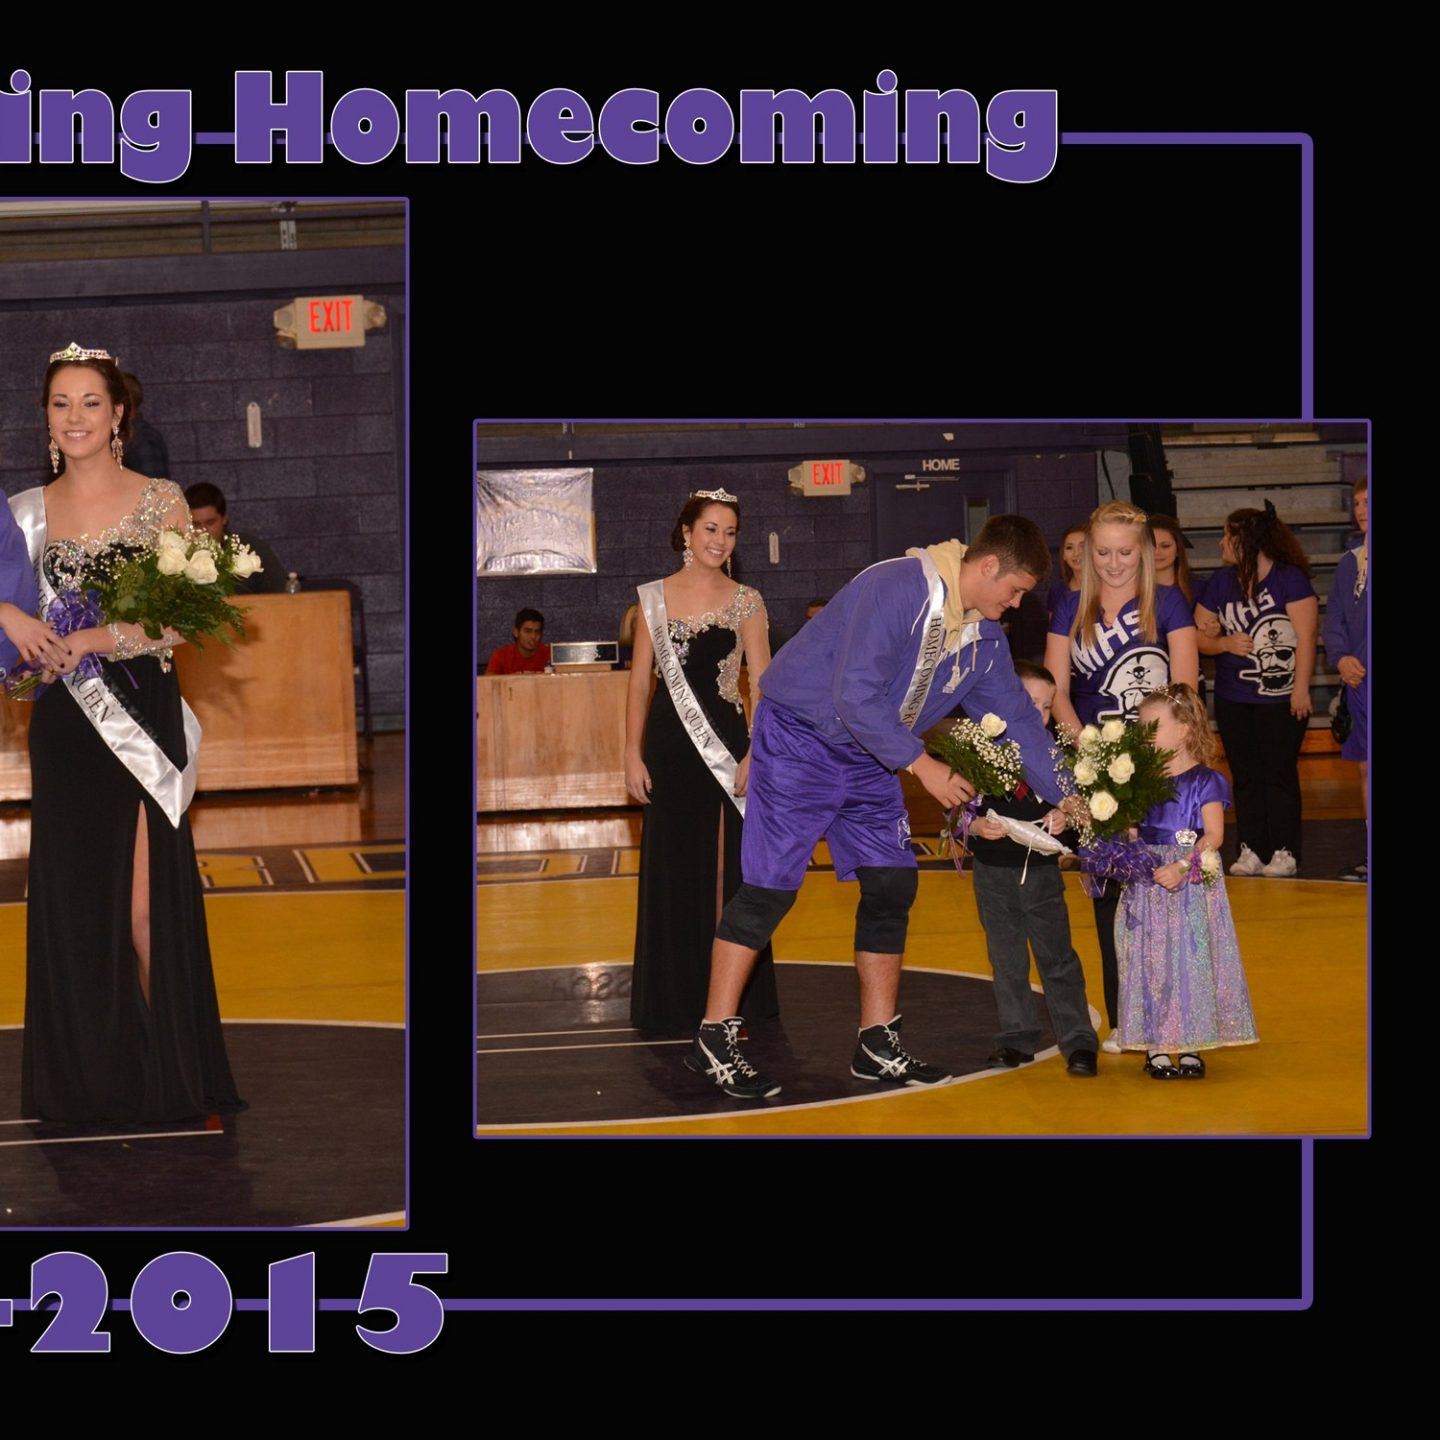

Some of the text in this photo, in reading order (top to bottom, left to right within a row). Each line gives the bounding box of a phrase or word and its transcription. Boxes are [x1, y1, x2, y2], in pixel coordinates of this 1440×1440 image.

[308, 299, 354, 334] EXIT
[812, 462, 844, 485] EXIT
[922, 458, 960, 472] HOME
[1217, 587, 1276, 636] MHS
[908, 617, 942, 711] HOMECOMING
[1071, 609, 1142, 680] MHS
[654, 625, 714, 749] HOMECOMING QUEEN
